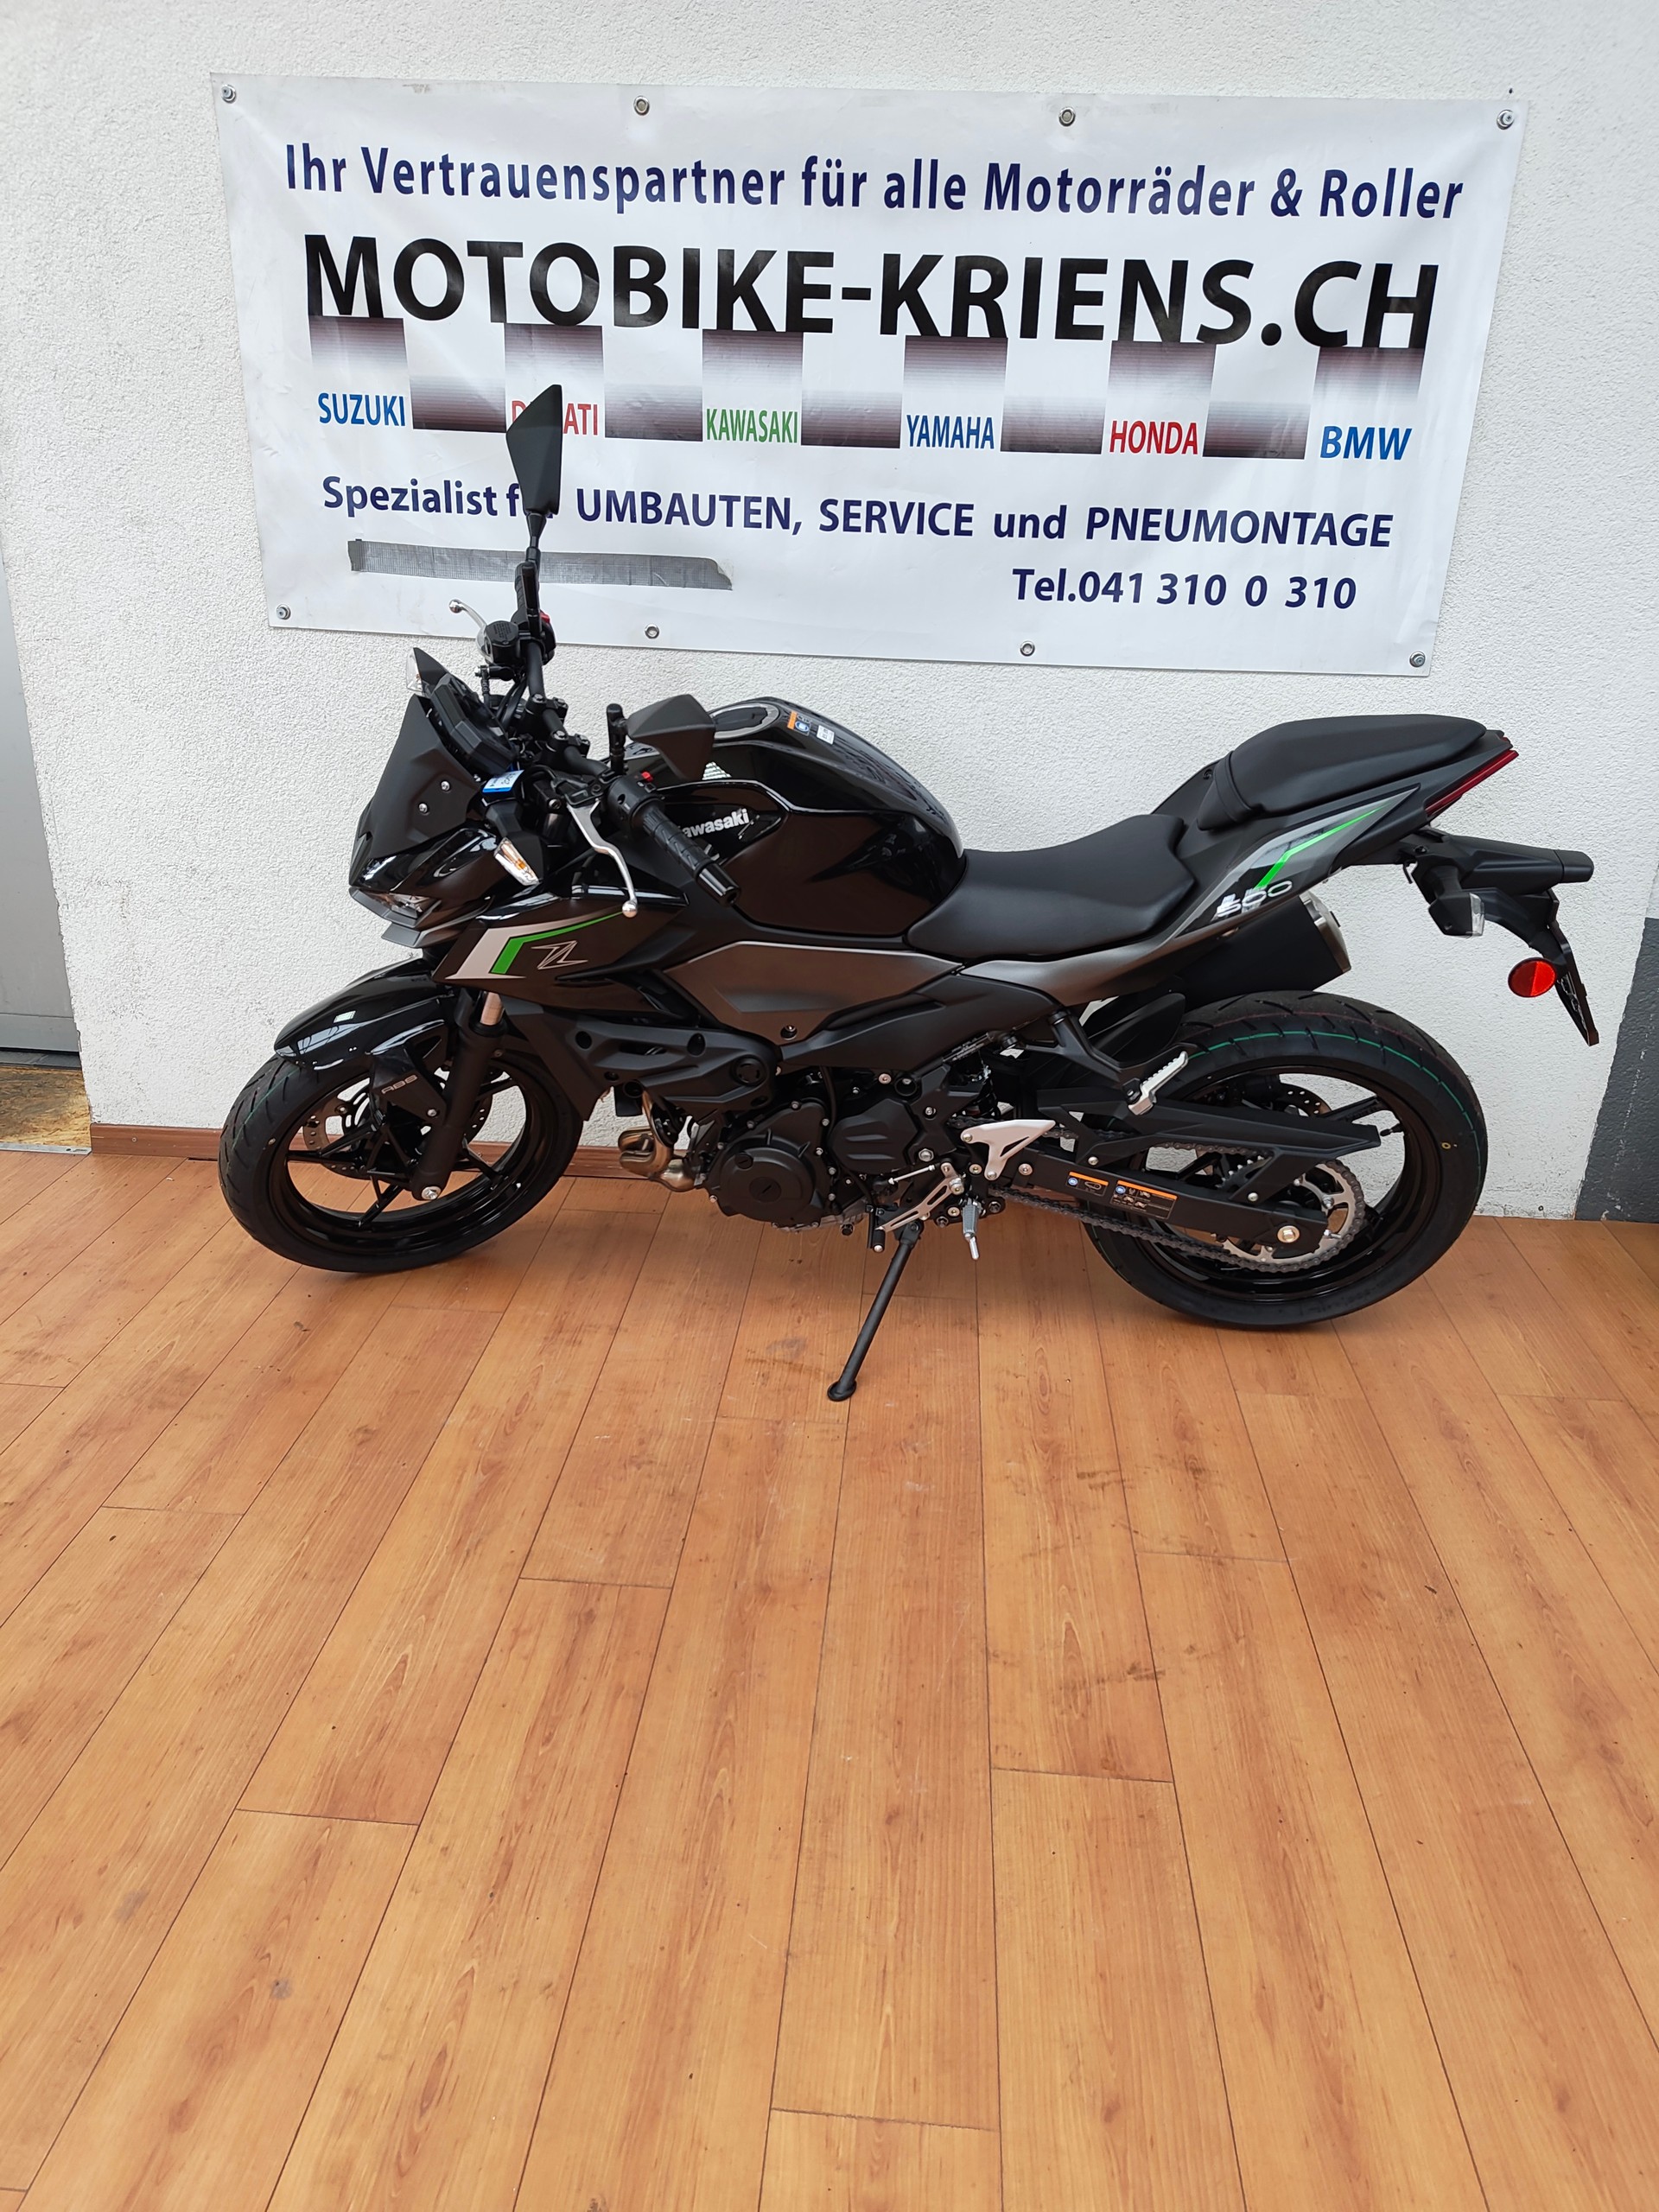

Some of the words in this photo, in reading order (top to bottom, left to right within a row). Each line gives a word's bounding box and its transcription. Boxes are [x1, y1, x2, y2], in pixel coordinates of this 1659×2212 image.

[286, 143, 346, 193] Ihr
[360, 146, 785, 214] Vertrauenspartner
[801, 155, 868, 207] für
[883, 158, 966, 211] alle
[983, 162, 1255, 216] Motorräder
[1270, 168, 1303, 218] &
[1319, 167, 1464, 219] Roller
[304, 234, 1440, 349] MOTOBIKE-KRIENS.CH
[318, 392, 406, 427] SUZUKI
[512, 400, 599, 435] DATI
[706, 408, 798, 443] KAWASAKI
[906, 414, 995, 449] YAMAHA
[1109, 420, 1198, 455] HONDA
[1319, 425, 1413, 461] BMW
[322, 475, 498, 518] Spezialist
[576, 488, 802, 536] UMBAUTEN,
[818, 498, 975, 537] SERVICE
[994, 504, 1067, 540] und
[1085, 506, 1394, 548] PNEUMONTAGE
[1012, 568, 1143, 604] Tel.041
[1156, 573, 1227, 607] 310
[1244, 575, 1268, 607] 0
[1284, 575, 1357, 609] 310
[679, 808, 750, 838] awasaki
[1217, 880, 1293, 918] 500
[381, 1074, 418, 1095] ABS
